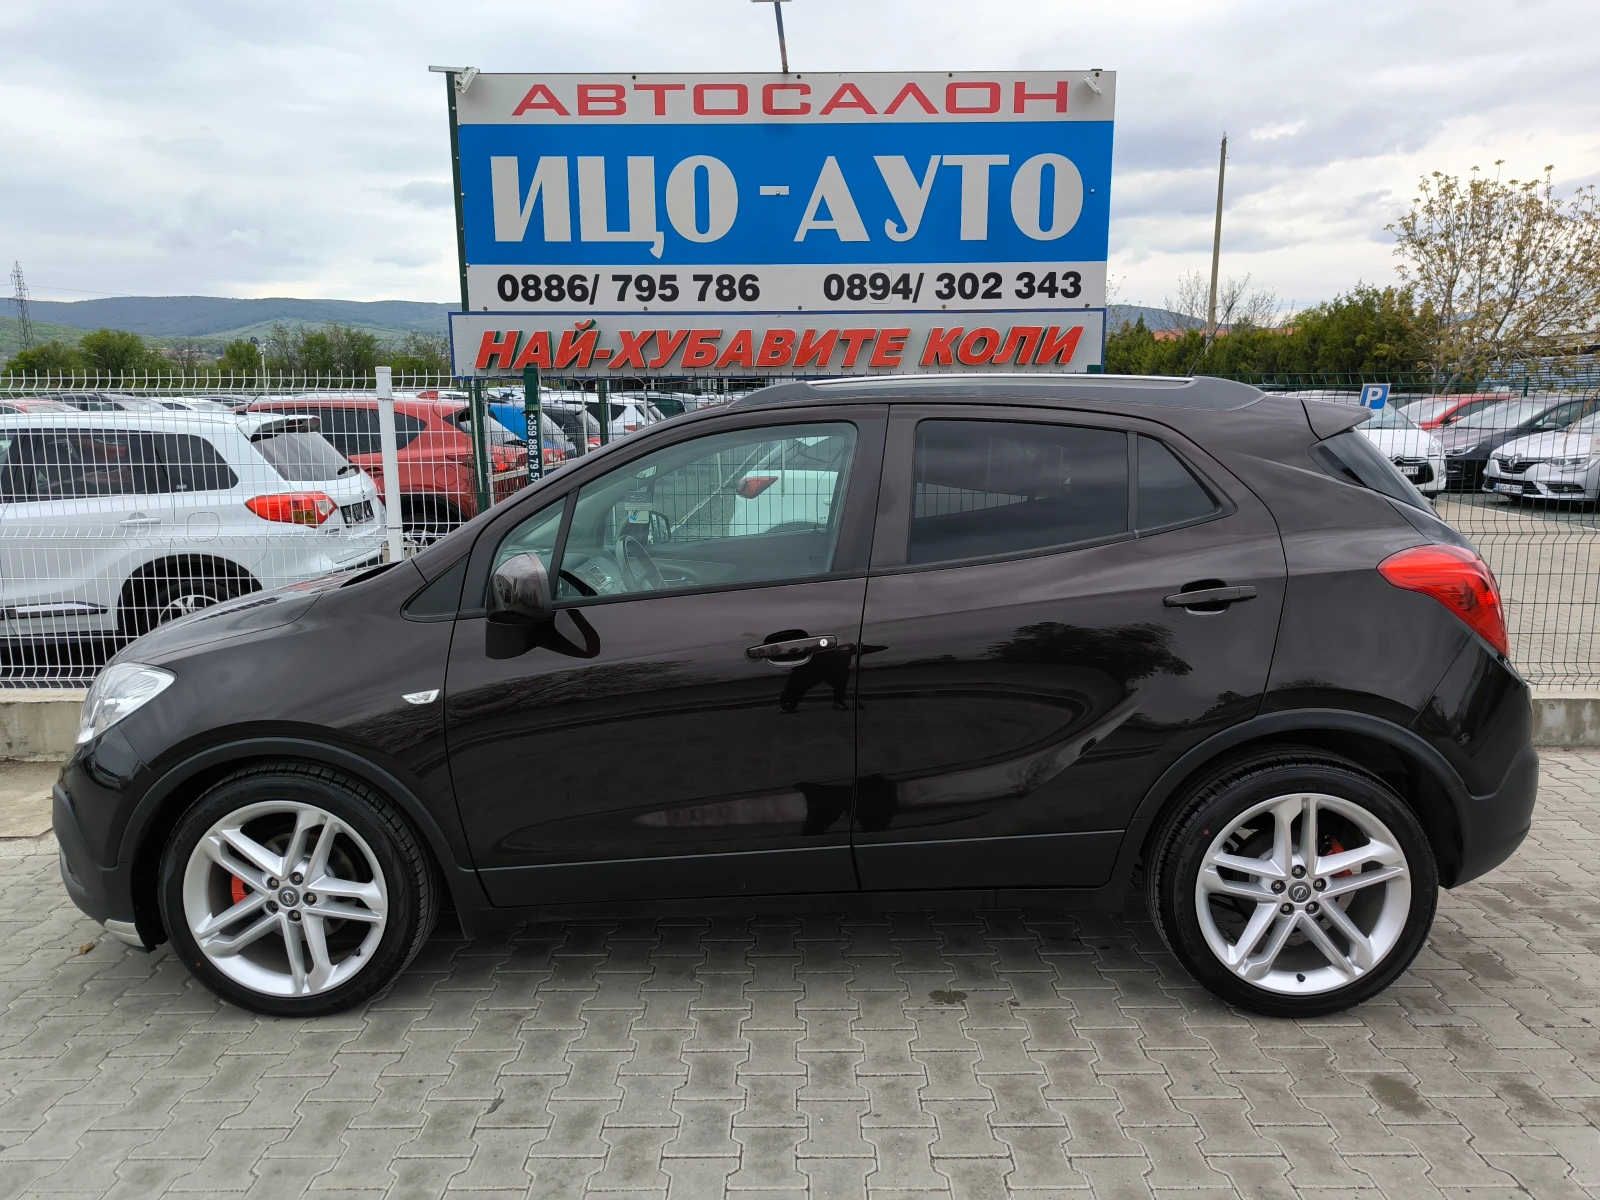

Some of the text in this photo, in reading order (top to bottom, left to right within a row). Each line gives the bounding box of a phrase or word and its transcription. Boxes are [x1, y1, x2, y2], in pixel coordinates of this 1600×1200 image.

[511, 80, 1069, 117] АВТОСАЛОН
[497, 273, 761, 306] 0886/ 795 786
[823, 270, 1082, 304] 0894/ 302 343
[473, 318, 1085, 370] НАЙ-ХУБАВИТЕ КОЛИ
[1364, 387, 1384, 408] P
[528, 413, 537, 436] +359
[528, 439, 538, 456] 886
[529, 458, 539, 469] 79
